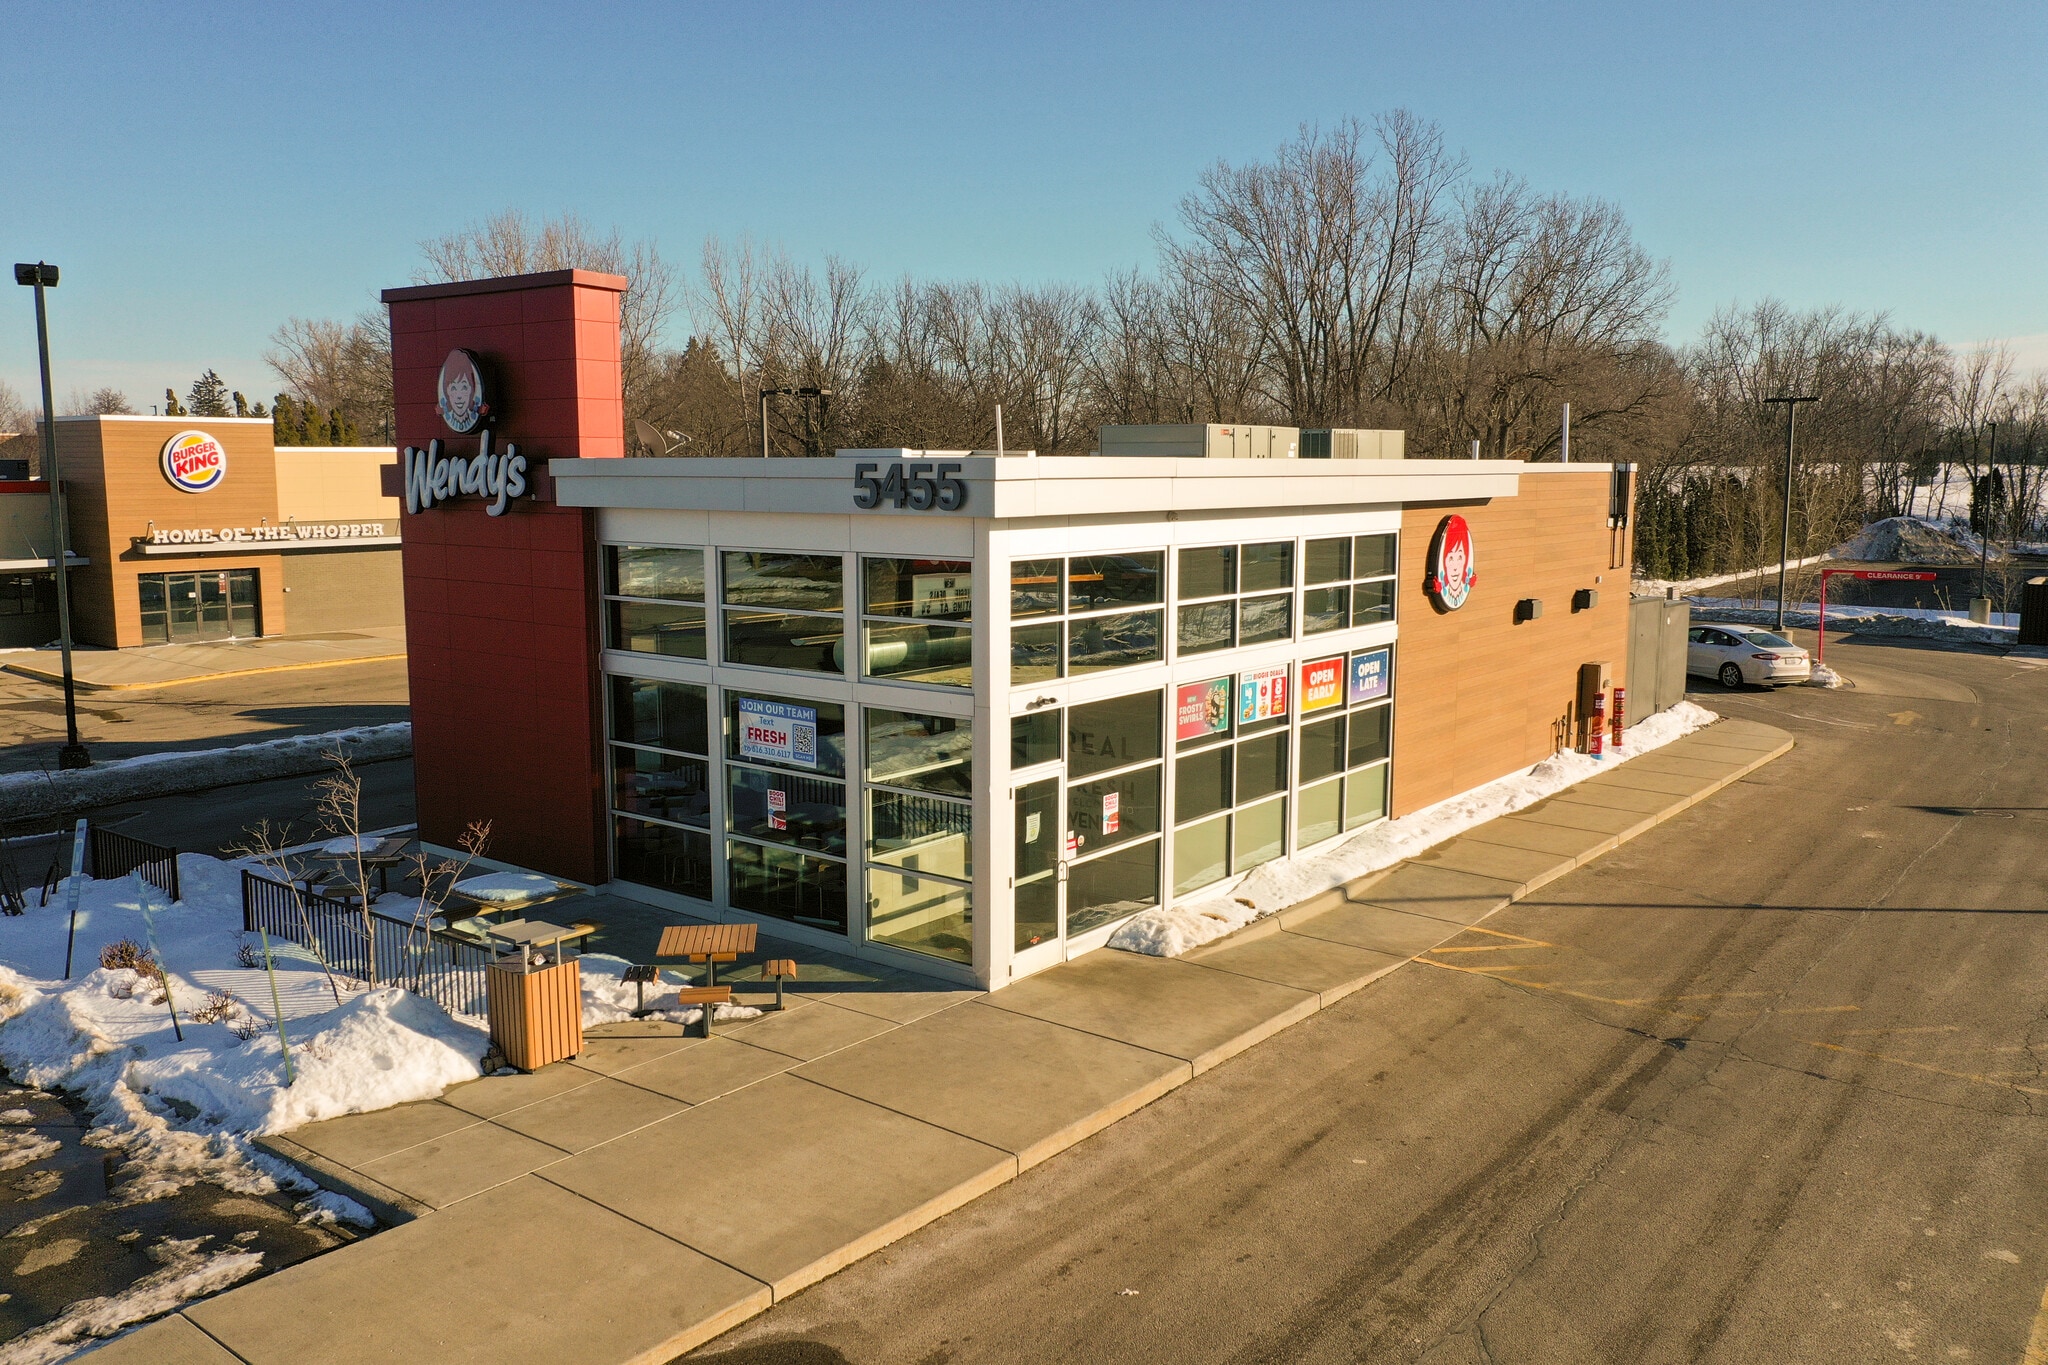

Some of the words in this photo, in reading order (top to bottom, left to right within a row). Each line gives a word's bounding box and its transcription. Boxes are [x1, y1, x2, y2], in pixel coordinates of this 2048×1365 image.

[173, 441, 217, 463] BURGER
[175, 451, 219, 478] KING
[404, 429, 527, 517] Wendy's
[853, 463, 963, 511] 5455
[153, 528, 214, 544] HOME
[219, 527, 248, 542] OF
[251, 526, 291, 540] THE
[295, 523, 385, 539] WHOPPER
[1867, 572, 1914, 580] CLEARANCE
[1253, 671, 1269, 680] BIGGIE
[1269, 669, 1284, 677] DEALS
[1309, 668, 1334, 686] OPEN
[1358, 660, 1380, 677] OPEN
[1359, 675, 1379, 692] LATE
[1308, 683, 1336, 702] EARLY
[741, 701, 763, 712] JOIN
[765, 704, 785, 716] OUR
[786, 707, 813, 720] TEAM!
[1179, 702, 1205, 716] FROSTY
[759, 716, 775, 726] Text
[1179, 712, 1204, 726] SWIRLS
[747, 726, 787, 746] FRESH
[752, 745, 791, 759] 616.310.6117
[769, 790, 784, 798] BOGO
[1105, 798, 1117, 807] CHILI
